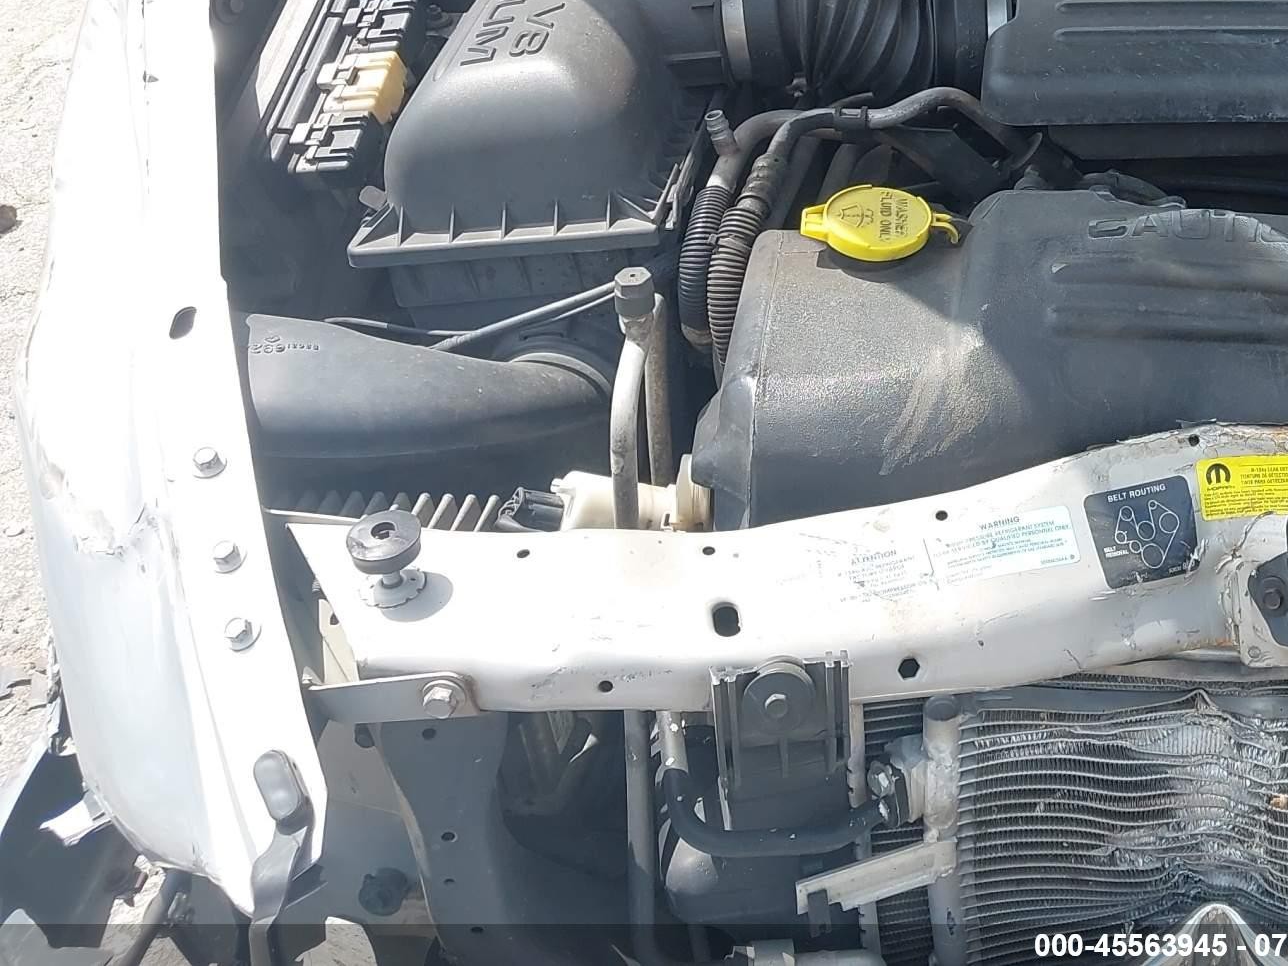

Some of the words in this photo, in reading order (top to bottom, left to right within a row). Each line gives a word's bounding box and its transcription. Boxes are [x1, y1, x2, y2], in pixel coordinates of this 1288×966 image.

[508, 1, 567, 58] V8
[1107, 492, 1127, 503] BELT
[1128, 483, 1167, 499] ROUTING
[979, 516, 1020, 531] WARNING
